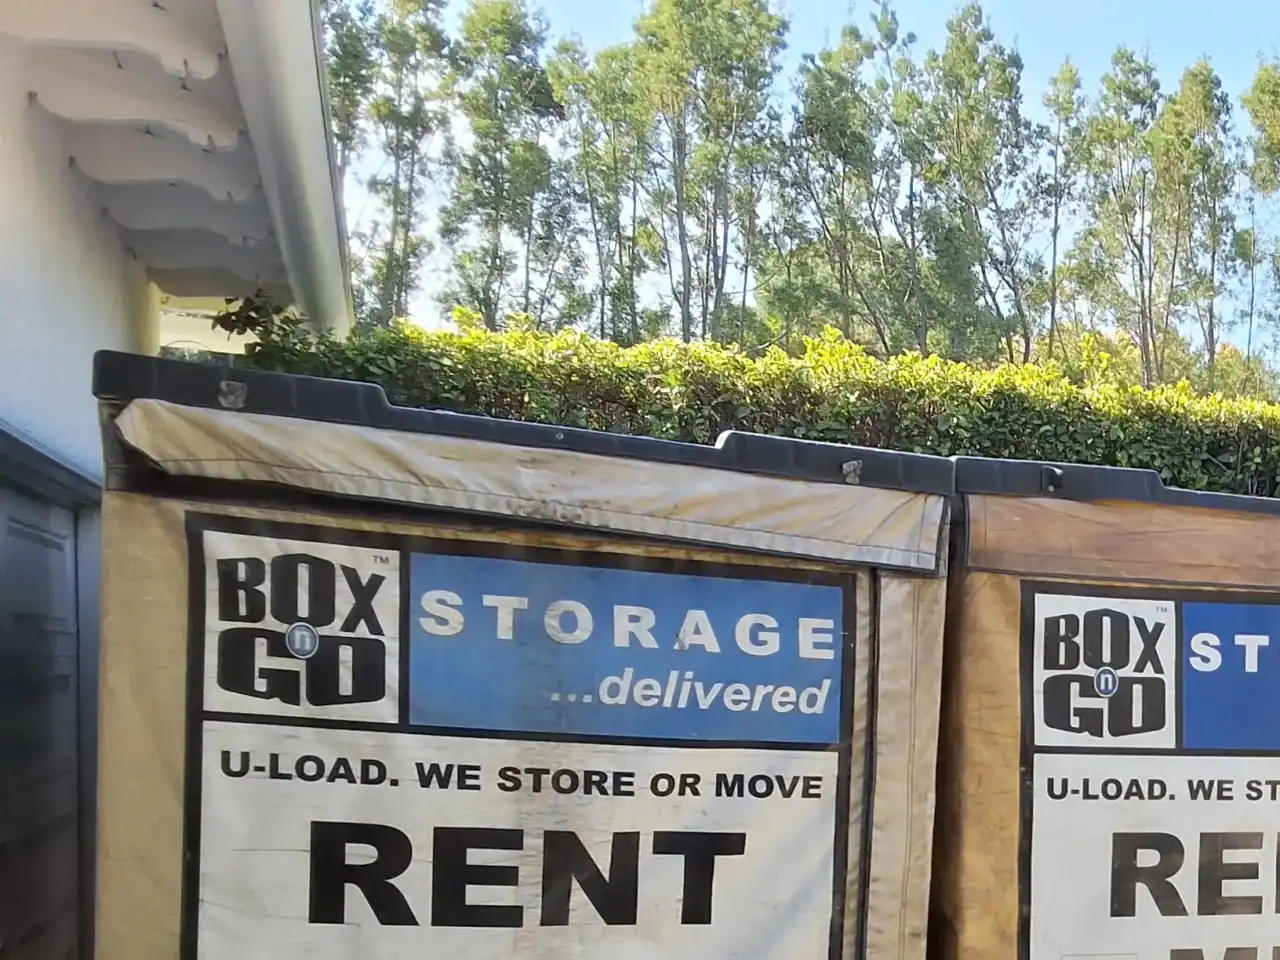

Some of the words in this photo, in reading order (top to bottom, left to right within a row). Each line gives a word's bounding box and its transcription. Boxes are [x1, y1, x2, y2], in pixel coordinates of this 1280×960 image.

[216, 553, 386, 636] BOX
[419, 590, 836, 660] STORAGE
[216, 627, 386, 707] GO
[1043, 607, 1166, 675] BOX
[1042, 674, 1166, 738] GO
[220, 750, 399, 788] U-LOAD.
[415, 763, 482, 791] WE
[496, 766, 635, 798] STORE
[650, 772, 702, 797] OR
[714, 773, 823, 799] MOVE
[1046, 778, 1176, 801] U-LOAD.
[1187, 779, 1234, 801] WE
[308, 820, 747, 927] RENT
